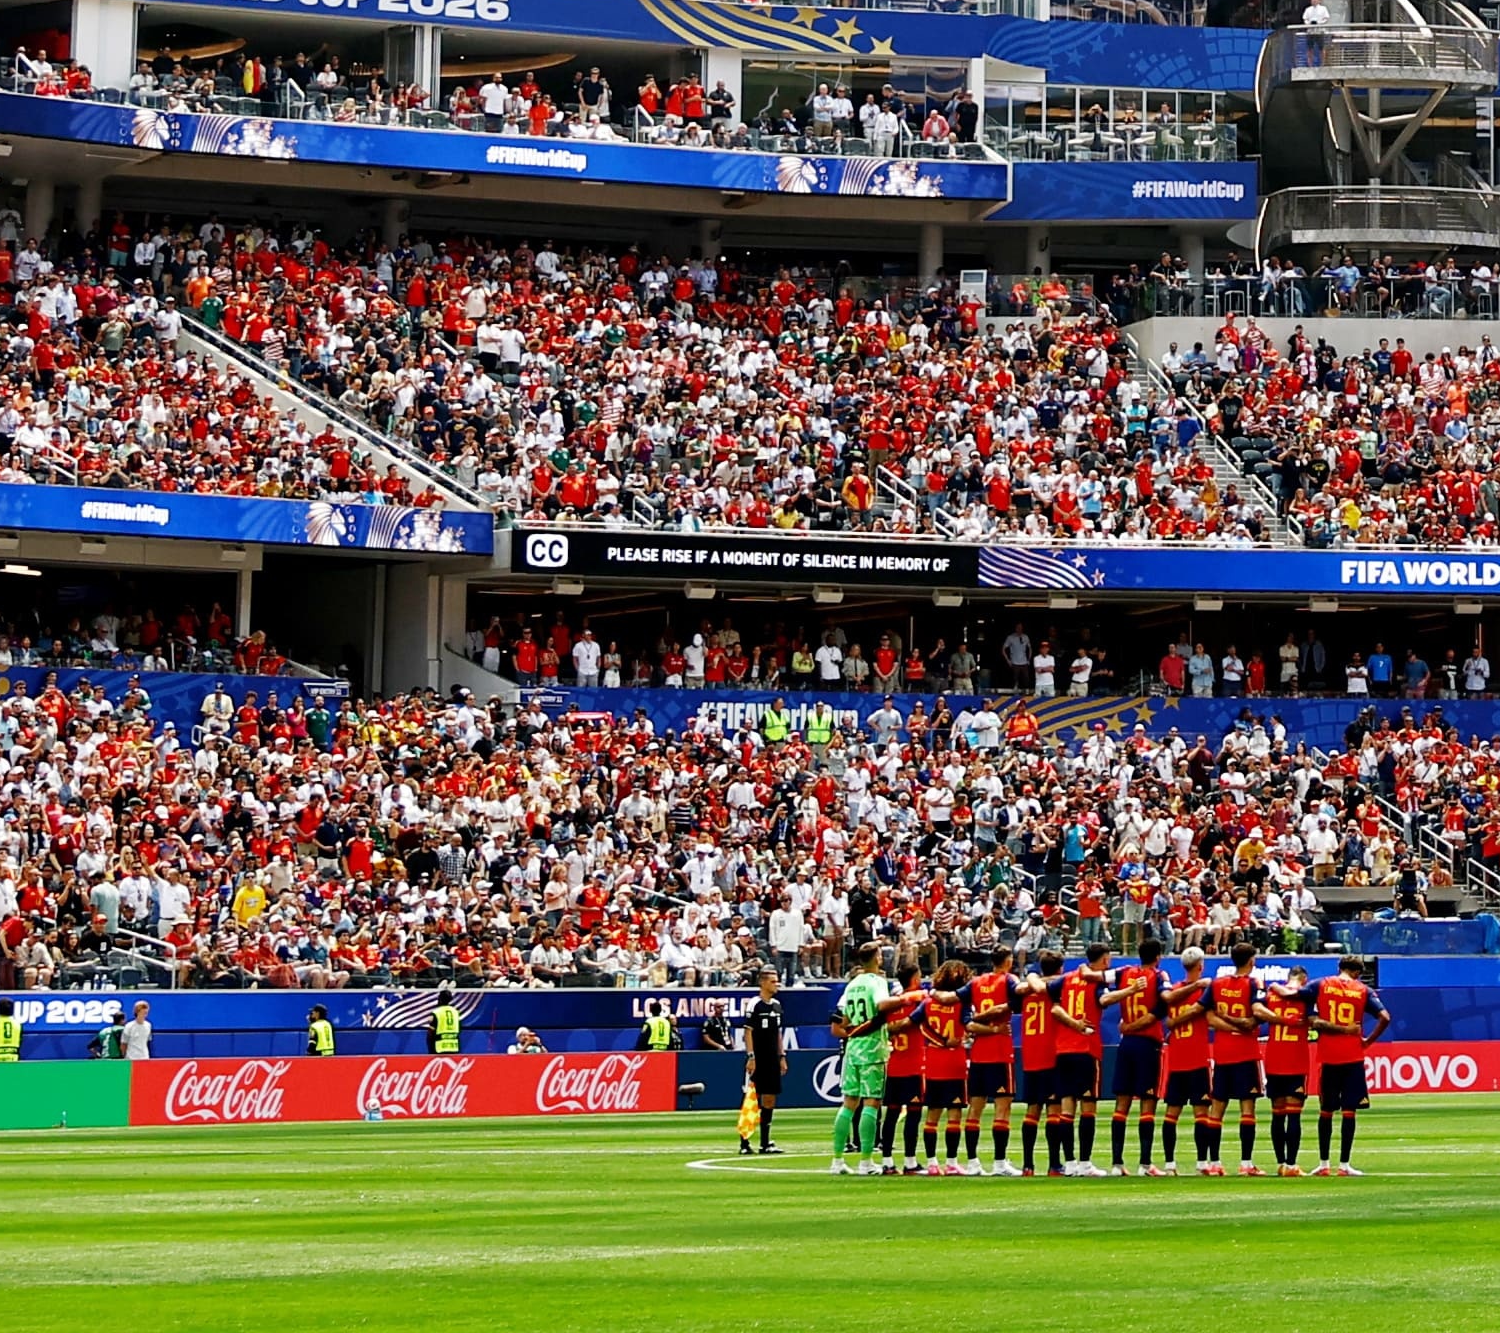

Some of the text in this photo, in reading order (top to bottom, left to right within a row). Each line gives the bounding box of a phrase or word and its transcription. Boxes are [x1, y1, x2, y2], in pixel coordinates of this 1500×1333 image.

[1132, 181, 1243, 201] #FIFAWorldCup
[531, 539, 563, 562] CC
[608, 547, 950, 571] PLEASE RISE IF A MOMENT OF SILENCE IN MEMORY OF
[1342, 561, 1400, 584] FIFA
[46, 1000, 122, 1024] 2026
[1025, 1001, 1045, 1035] 21
[536, 1054, 648, 1113] Coca-Cola
[1364, 1055, 1478, 1090] novo
[165, 1058, 292, 1122] Coca-Cola
[357, 1056, 476, 1119] Coca-Cola
